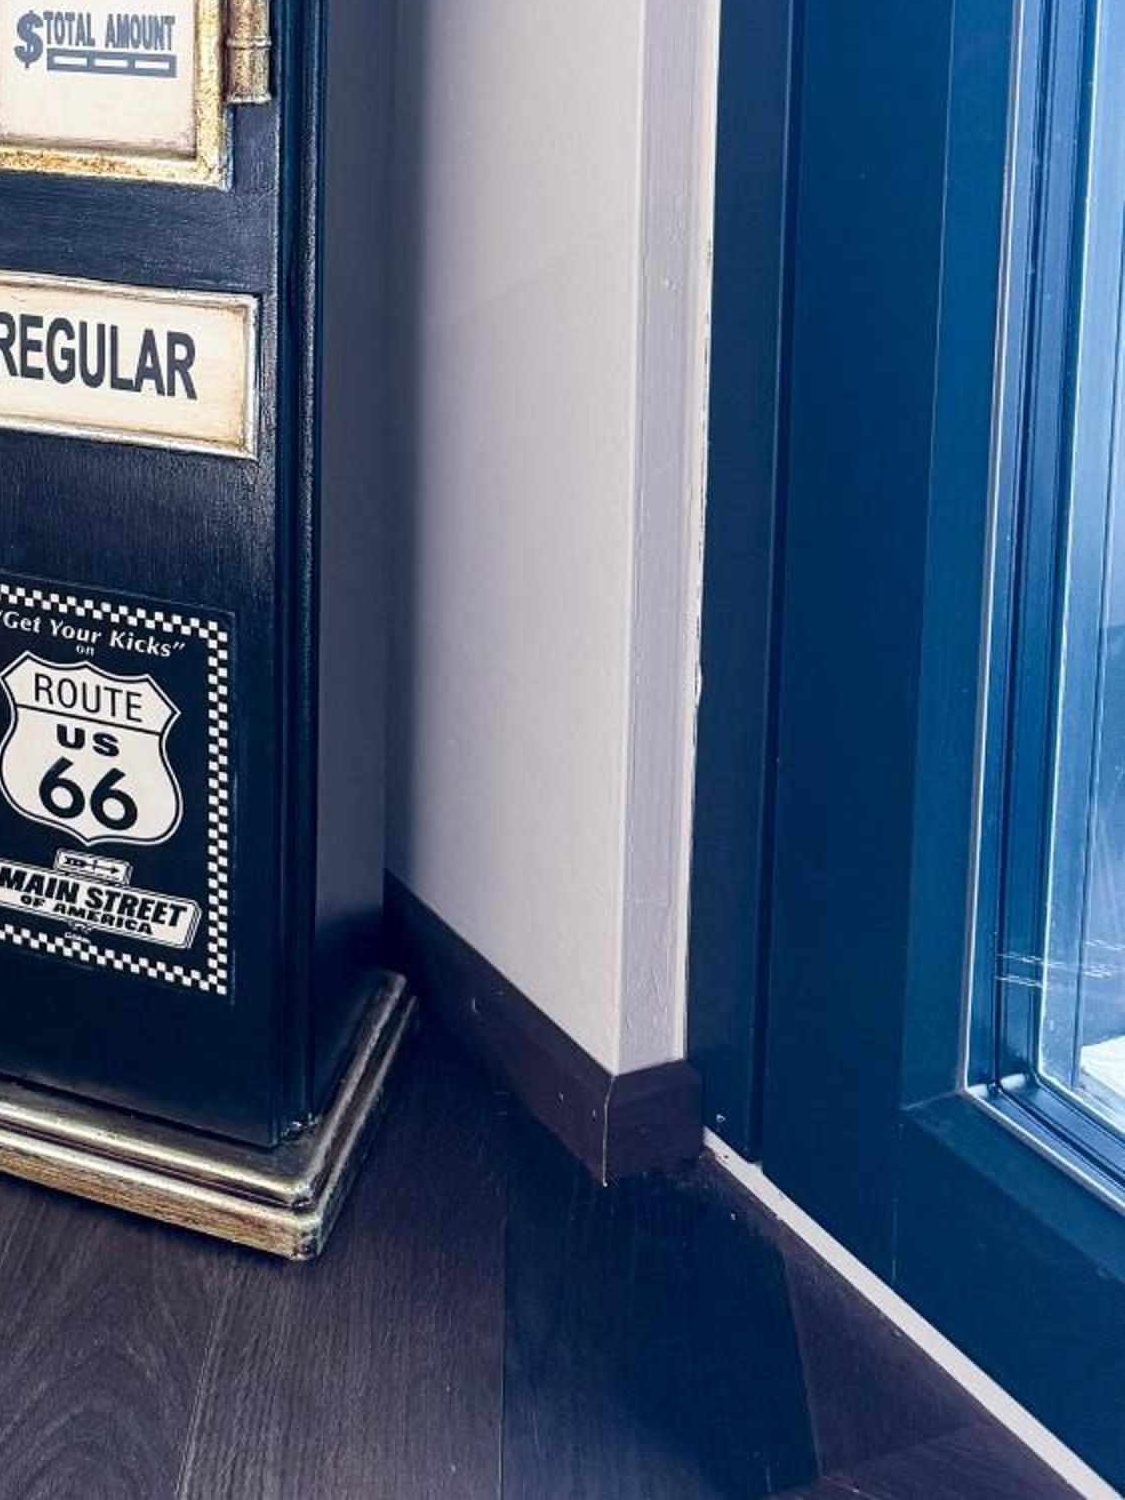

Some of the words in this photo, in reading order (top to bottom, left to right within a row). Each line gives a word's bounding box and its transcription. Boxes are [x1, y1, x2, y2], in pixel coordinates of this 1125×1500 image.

[104, 13, 175, 50] AMOUNT
[50, 619, 102, 644] Your
[76, 643, 95, 656] on
[34, 672, 143, 723] ROUTE
[56, 723, 120, 757] US
[38, 756, 138, 831] 66
[20, 895, 46, 908] OF
[53, 902, 153, 935] AMERICA
[86, 887, 187, 927] STREET
